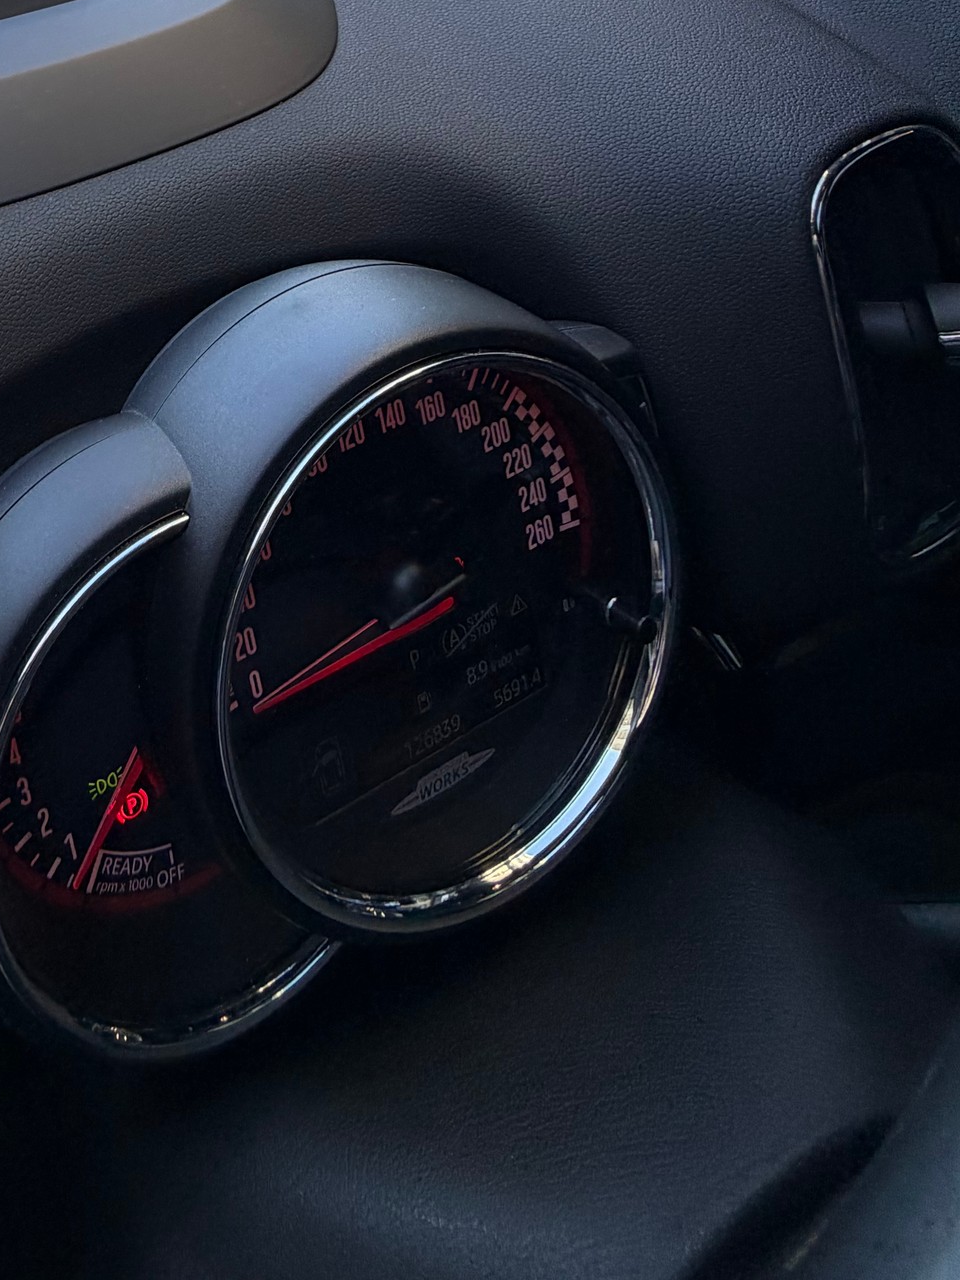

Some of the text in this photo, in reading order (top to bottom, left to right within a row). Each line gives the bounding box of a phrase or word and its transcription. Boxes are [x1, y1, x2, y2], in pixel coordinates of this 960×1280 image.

[375, 398, 406, 434] 140
[415, 390, 446, 425] 160
[451, 399, 481, 433] 180
[339, 419, 366, 453] 120
[481, 417, 511, 453] 200
[503, 443, 532, 479] 220
[518, 477, 547, 513] 240
[525, 514, 555, 551] 260
[234, 626, 258, 662] 20
[470, 619, 497, 642] STOP
[248, 670, 263, 698] 0
[9, 737, 22, 766] 4
[16, 777, 33, 806] 3
[419, 761, 470, 801] WORKS
[37, 807, 53, 838] 2
[64, 832, 78, 861] 1
[101, 854, 153, 876] READY
[156, 863, 185, 888] OFF
[95, 880, 119, 895] rpm
[128, 876, 154, 893] 1000
